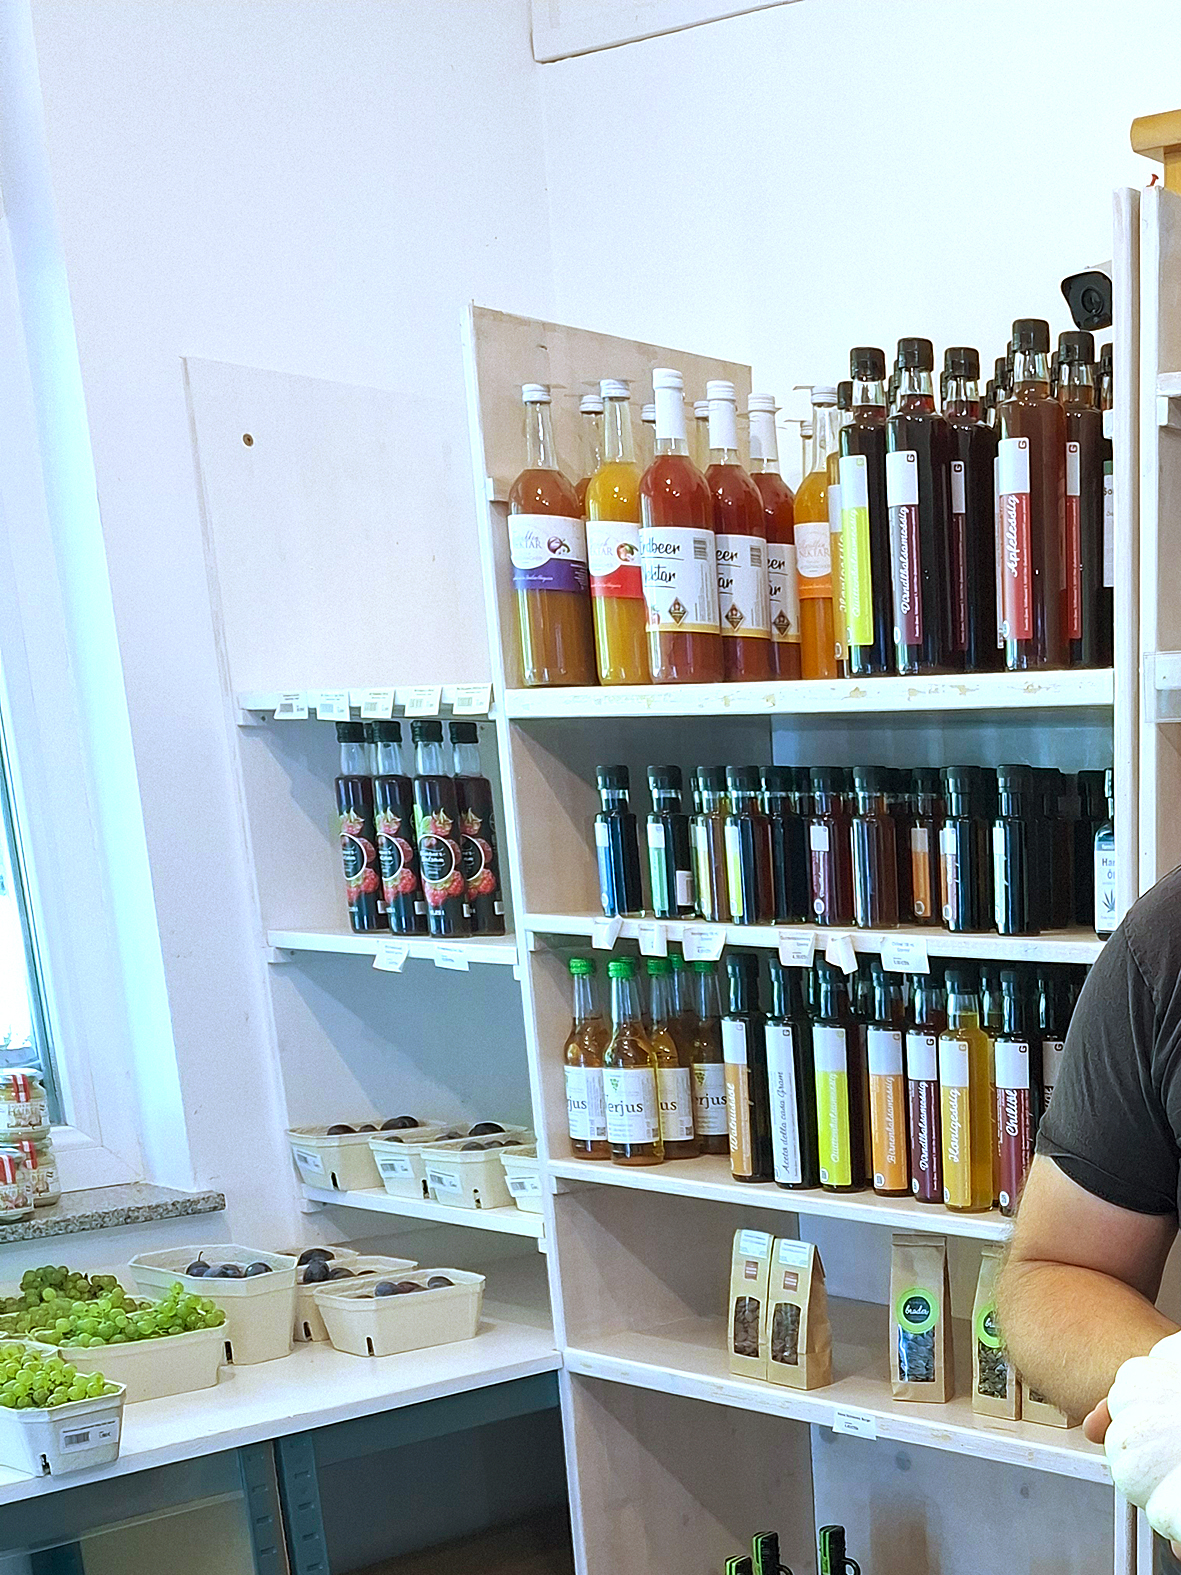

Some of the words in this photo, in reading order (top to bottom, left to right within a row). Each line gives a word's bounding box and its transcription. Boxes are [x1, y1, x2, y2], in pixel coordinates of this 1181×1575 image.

[1004, 494, 1020, 578] Apfelessig
[606, 1095, 644, 1117] erjus
[948, 1087, 962, 1163] Honigessig
[1005, 1089, 1018, 1137] Chiliöl
